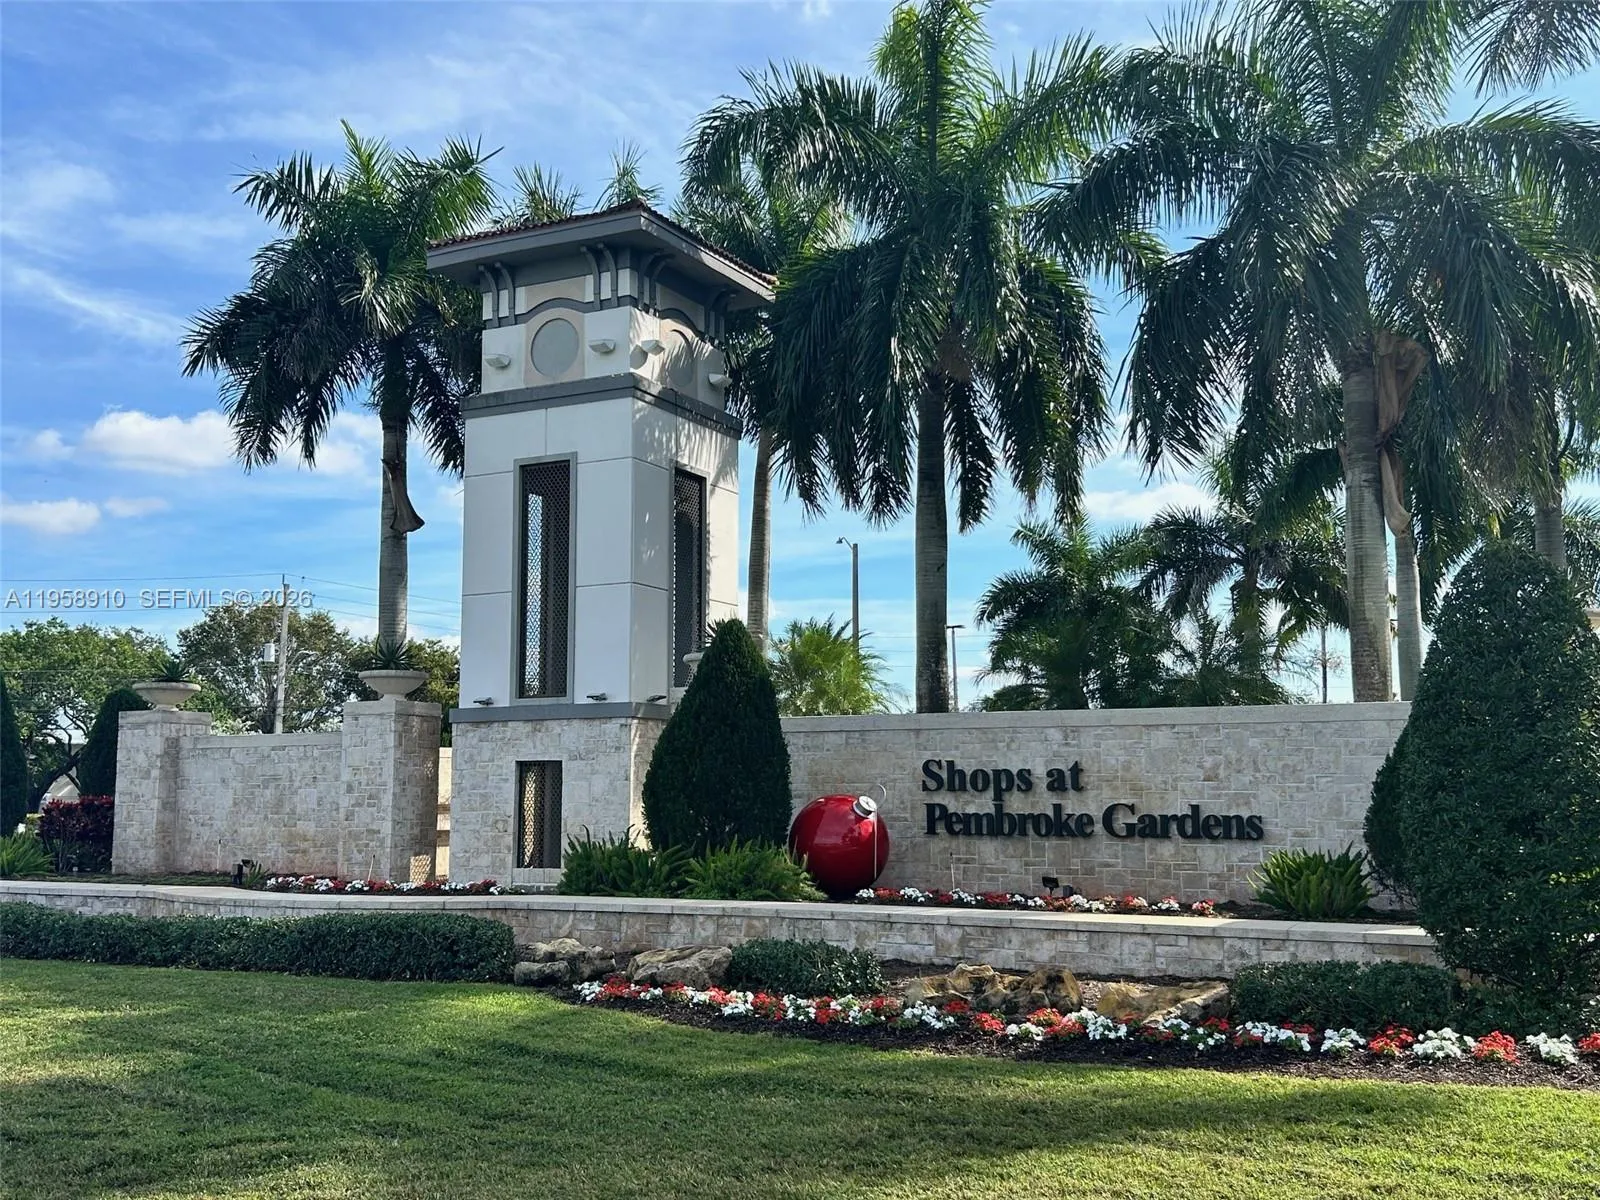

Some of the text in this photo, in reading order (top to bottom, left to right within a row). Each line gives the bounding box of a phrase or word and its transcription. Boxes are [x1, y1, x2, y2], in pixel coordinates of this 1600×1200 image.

[921, 758, 1084, 801] Shops at
[924, 802, 1265, 841] Pembroke Gardens
